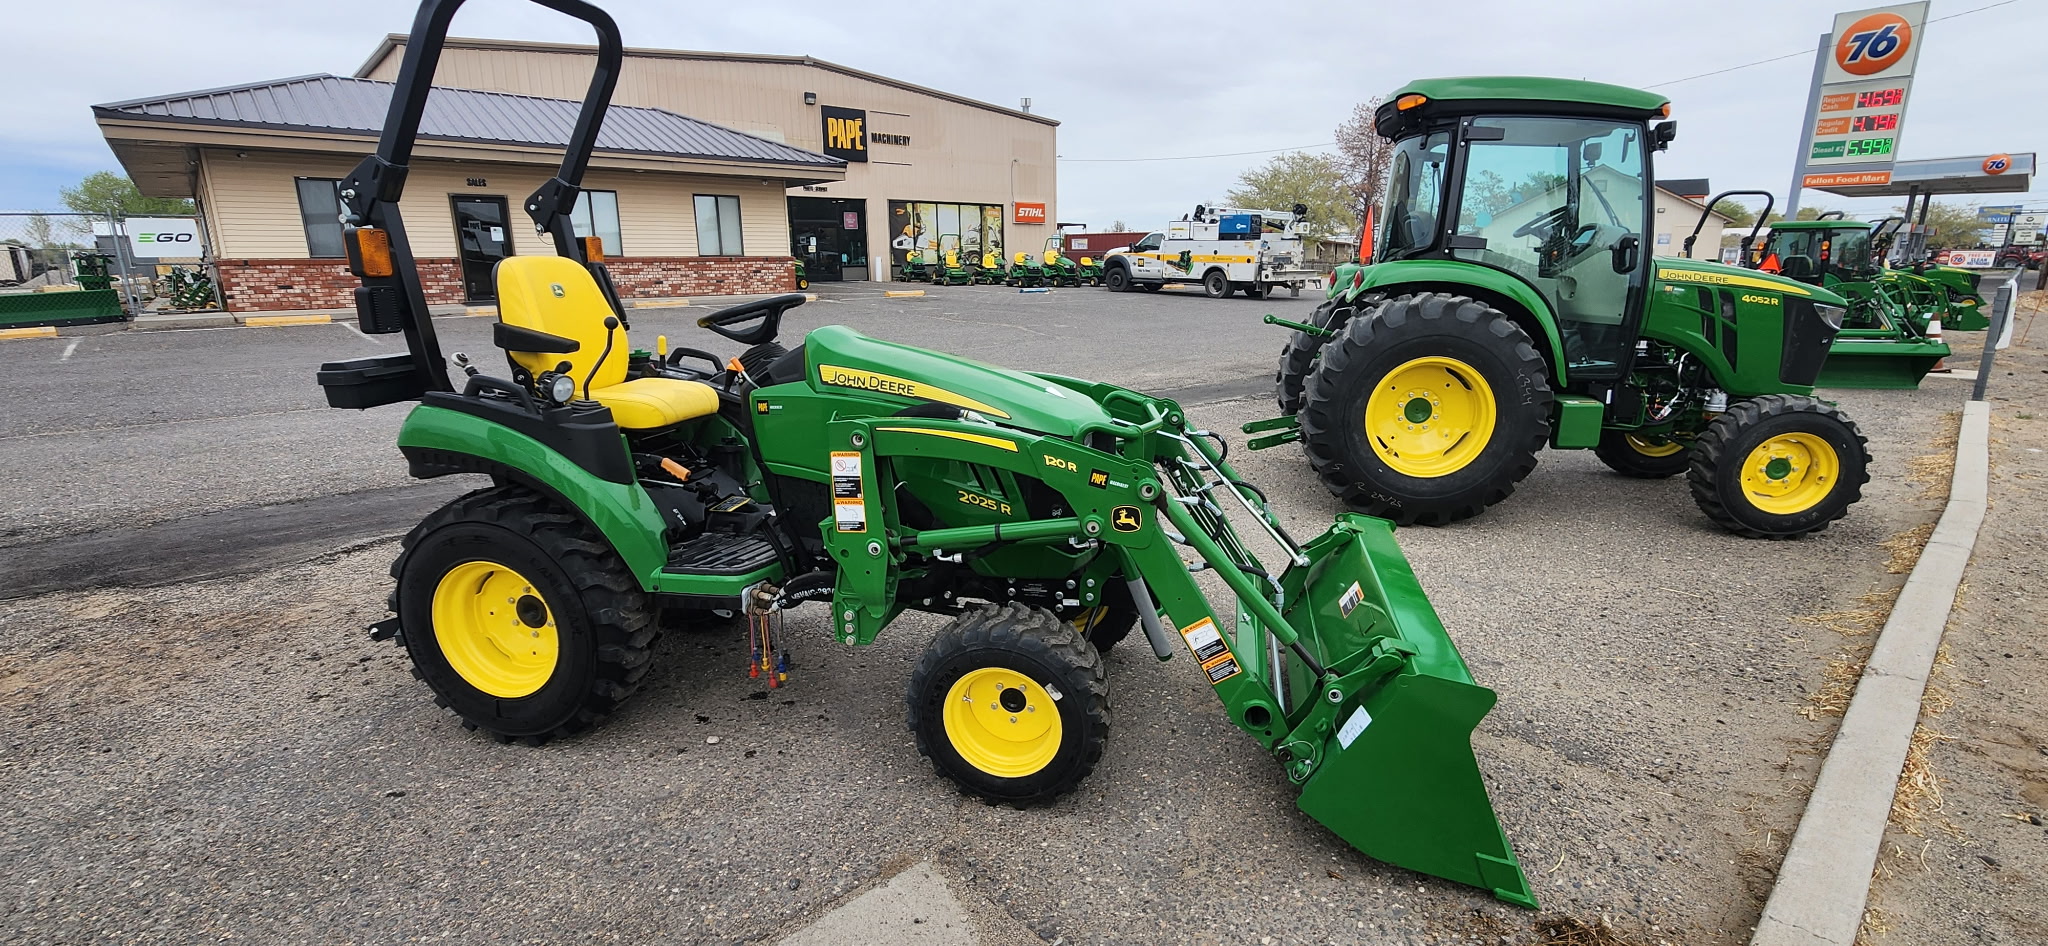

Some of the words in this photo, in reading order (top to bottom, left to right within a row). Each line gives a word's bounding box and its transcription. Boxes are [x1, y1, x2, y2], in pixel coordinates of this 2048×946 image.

[1846, 24, 1901, 63] 76
[1822, 95, 1849, 104] Regular
[1858, 88, 1896, 107] 4.69
[1818, 119, 1845, 127] Regular
[1853, 114, 1890, 131] 4.79
[871, 132, 911, 147] MACHINERY
[1812, 146, 1835, 154] Diesel
[1835, 145, 1845, 153] #2
[1847, 138, 1884, 156] 5.99
[1987, 158, 2006, 171] 76
[466, 178, 487, 187] SALES
[1806, 176, 1834, 185] Fallon
[1836, 175, 1860, 183] Food
[1017, 207, 1044, 217] STIHL
[137, 232, 193, 243] EGO
[1663, 271, 1692, 281] JOHN
[1693, 273, 1729, 284] DEERE
[829, 371, 866, 387] JOHN
[869, 376, 916, 396] DEERE
[1043, 454, 1064, 469] 120
[957, 490, 997, 510] 2025
[1000, 502, 1012, 516] R
